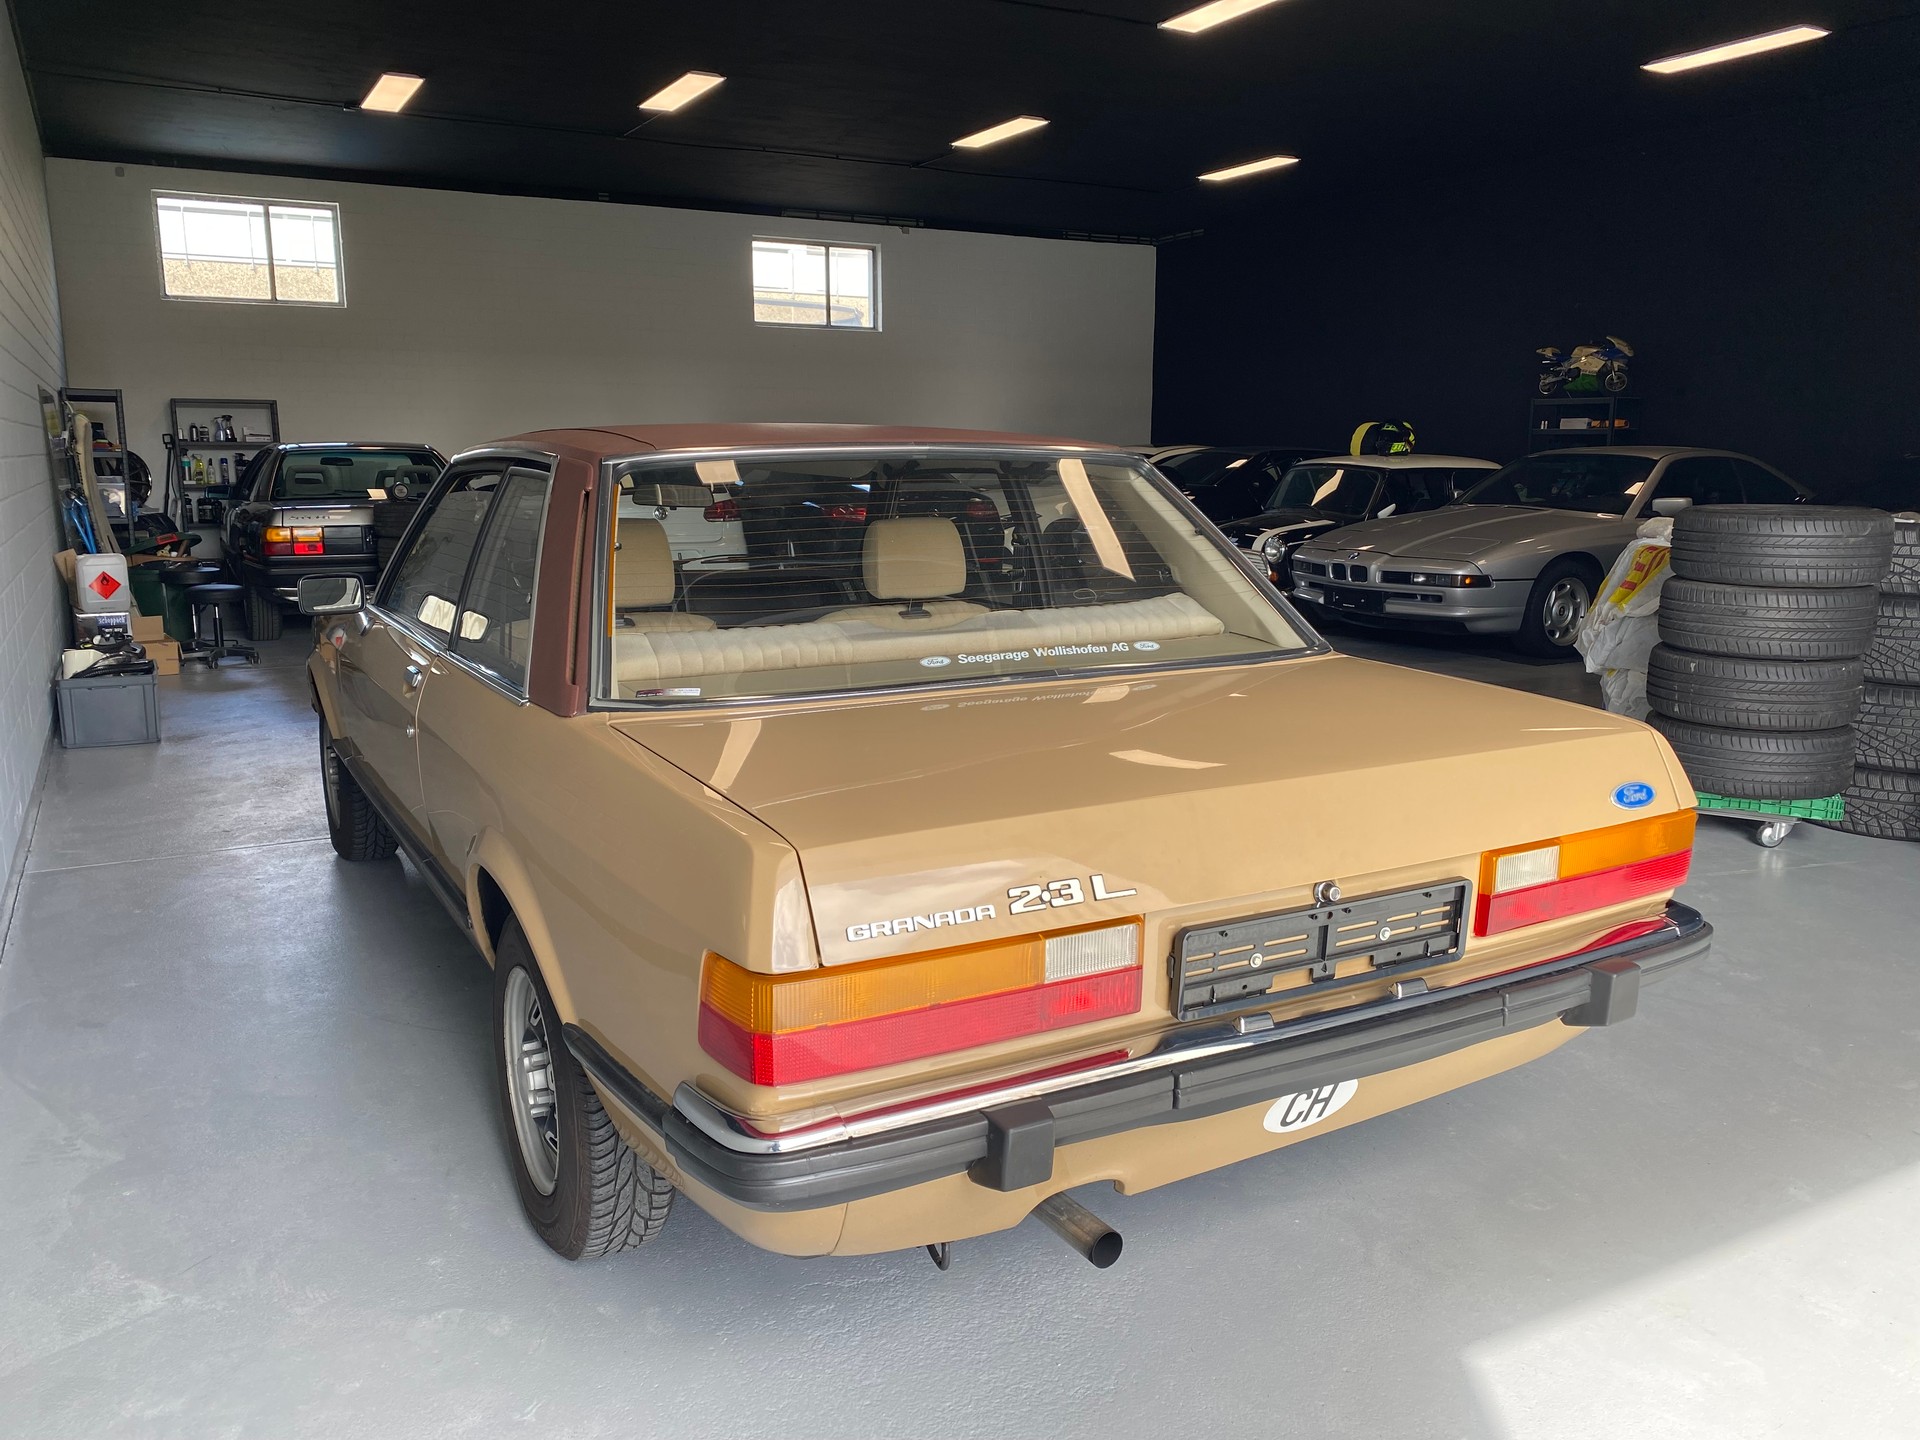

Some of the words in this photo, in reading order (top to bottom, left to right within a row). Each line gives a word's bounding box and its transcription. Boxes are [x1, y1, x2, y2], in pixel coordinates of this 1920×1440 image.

[957, 650, 1030, 664] Seegarage
[1033, 644, 1108, 657] Wollishofen
[1111, 642, 1130, 652] AG
[1622, 785, 1649, 804] Ford
[846, 904, 997, 942] GRANADA
[1089, 874, 1138, 901] L
[1280, 1083, 1340, 1128] CH
